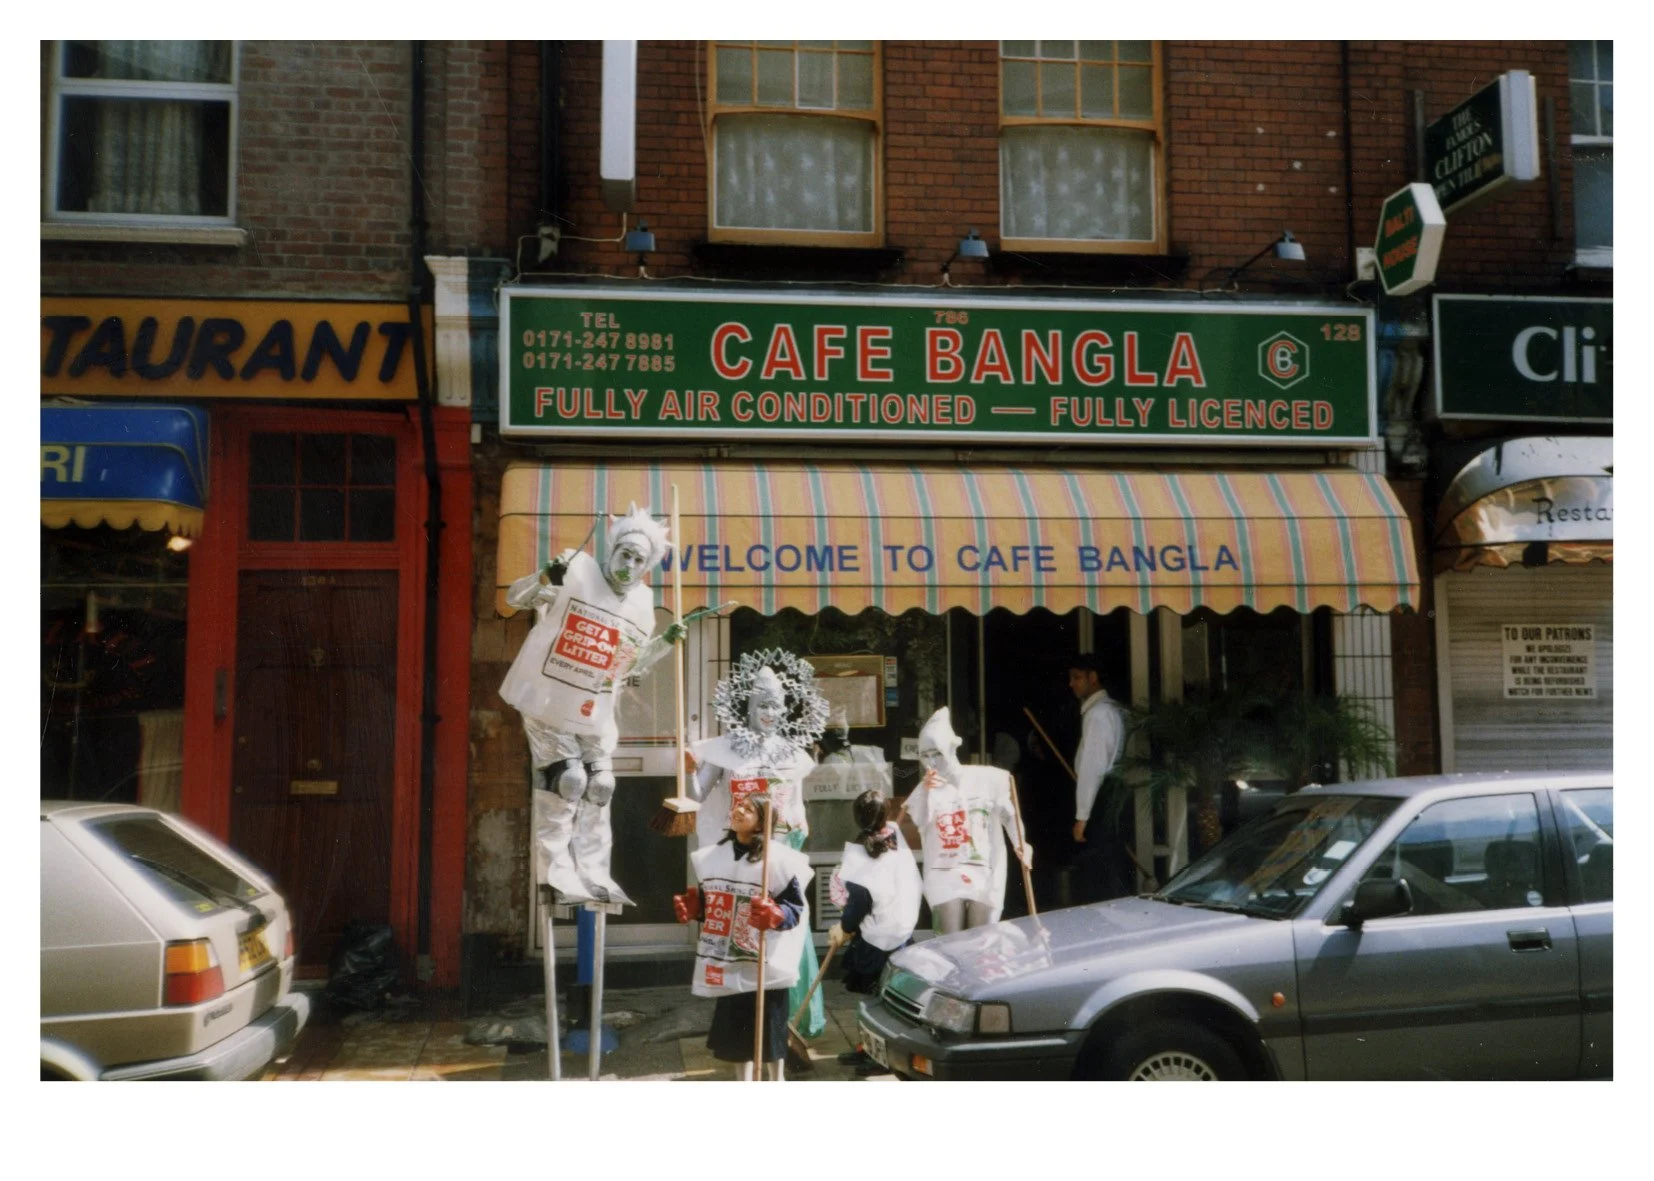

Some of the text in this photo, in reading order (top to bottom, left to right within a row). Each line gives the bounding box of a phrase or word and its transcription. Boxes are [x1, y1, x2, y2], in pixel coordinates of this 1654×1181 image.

[1435, 132, 1494, 179] CLIFTON
[580, 312, 620, 329] TEL
[522, 329, 675, 352] 0171-247 8981
[1320, 323, 1362, 342] 128
[522, 351, 676, 374] 0171-247 7885
[710, 321, 1207, 389] CAFE BANGLA
[1511, 325, 1606, 384] Cli
[533, 386, 648, 420] FULLY
[658, 388, 721, 422] AIR
[731, 389, 977, 427] CONDITIONED
[1050, 395, 1154, 429] FULLY
[1167, 397, 1335, 431] LICENCED
[40, 444, 88, 483] RI
[659, 543, 1240, 574] WELCOME TO CAFE BANGLA
[563, 630, 596, 648] GRIP
[575, 620, 602, 637] GET
[599, 629, 610, 642] A
[1504, 627, 1592, 640] TO OUR PATRONS
[550, 657, 574, 671] EVERY
[562, 642, 609, 667] LITTER
